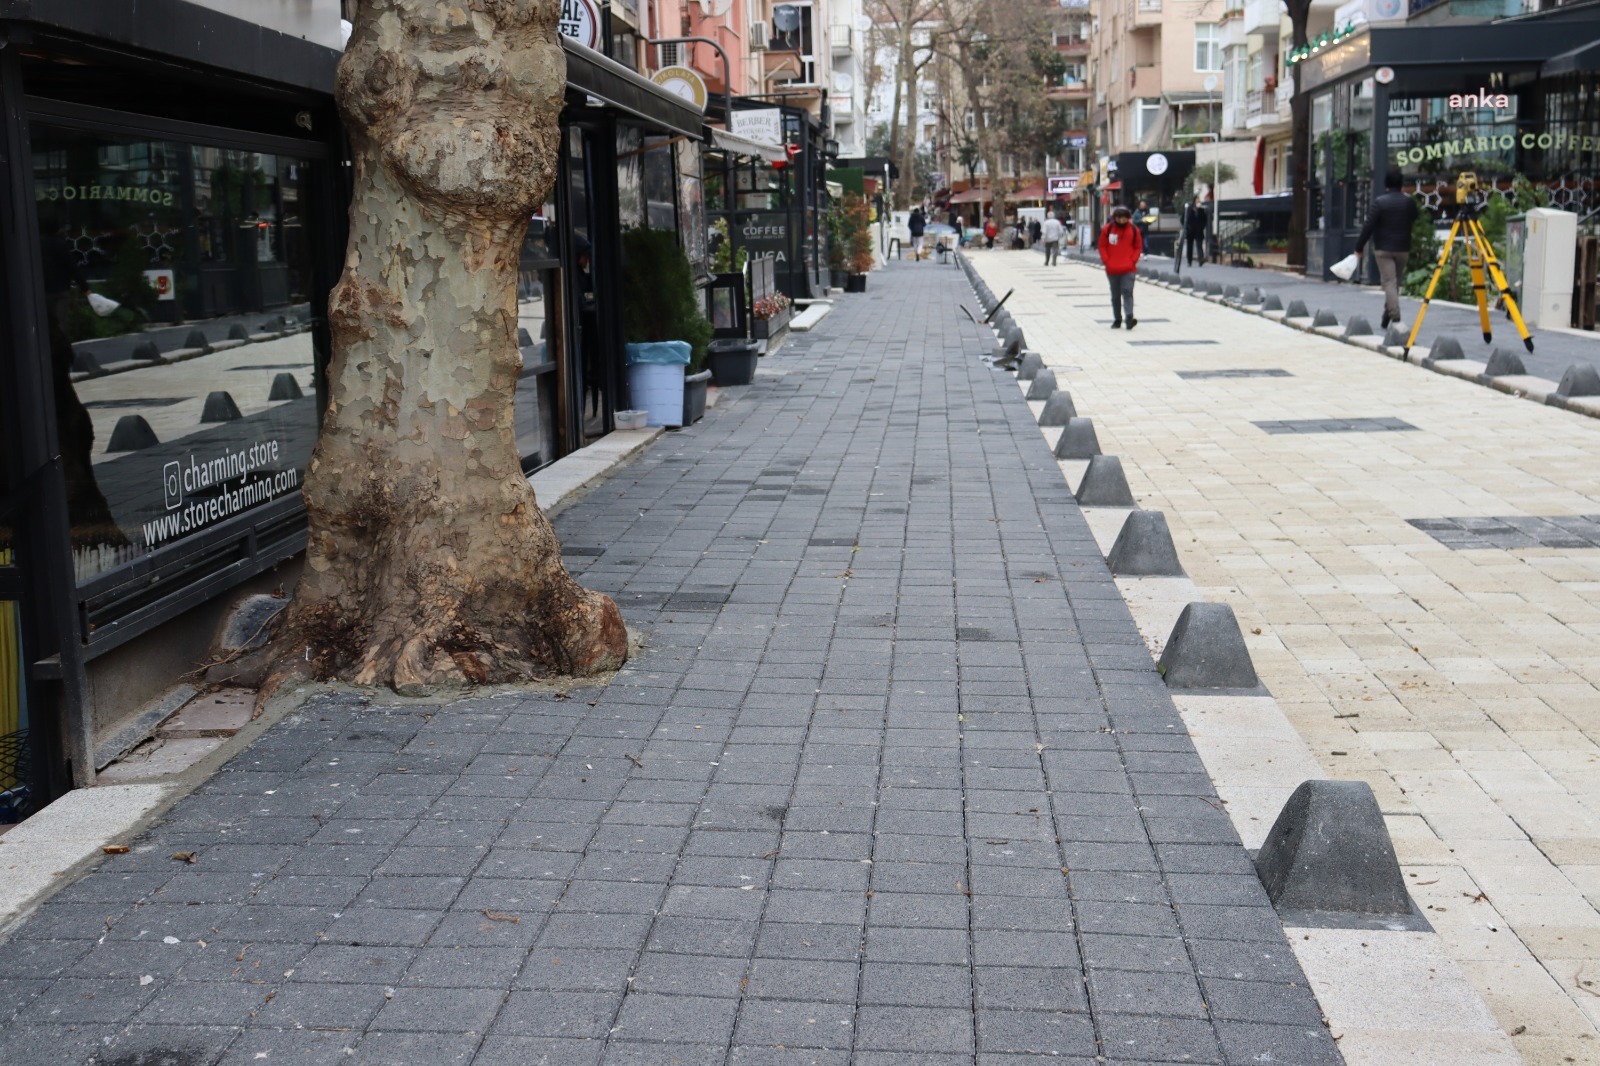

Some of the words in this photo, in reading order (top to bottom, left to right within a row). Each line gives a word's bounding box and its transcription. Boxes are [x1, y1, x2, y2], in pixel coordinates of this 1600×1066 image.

[557, 23, 580, 37] EE
[1449, 87, 1509, 108] anka
[1396, 134, 1515, 167] SOMMARIO
[742, 225, 786, 236] COFFEE
[184, 440, 278, 492] charming.store
[143, 467, 297, 546] www.storecharming.com
